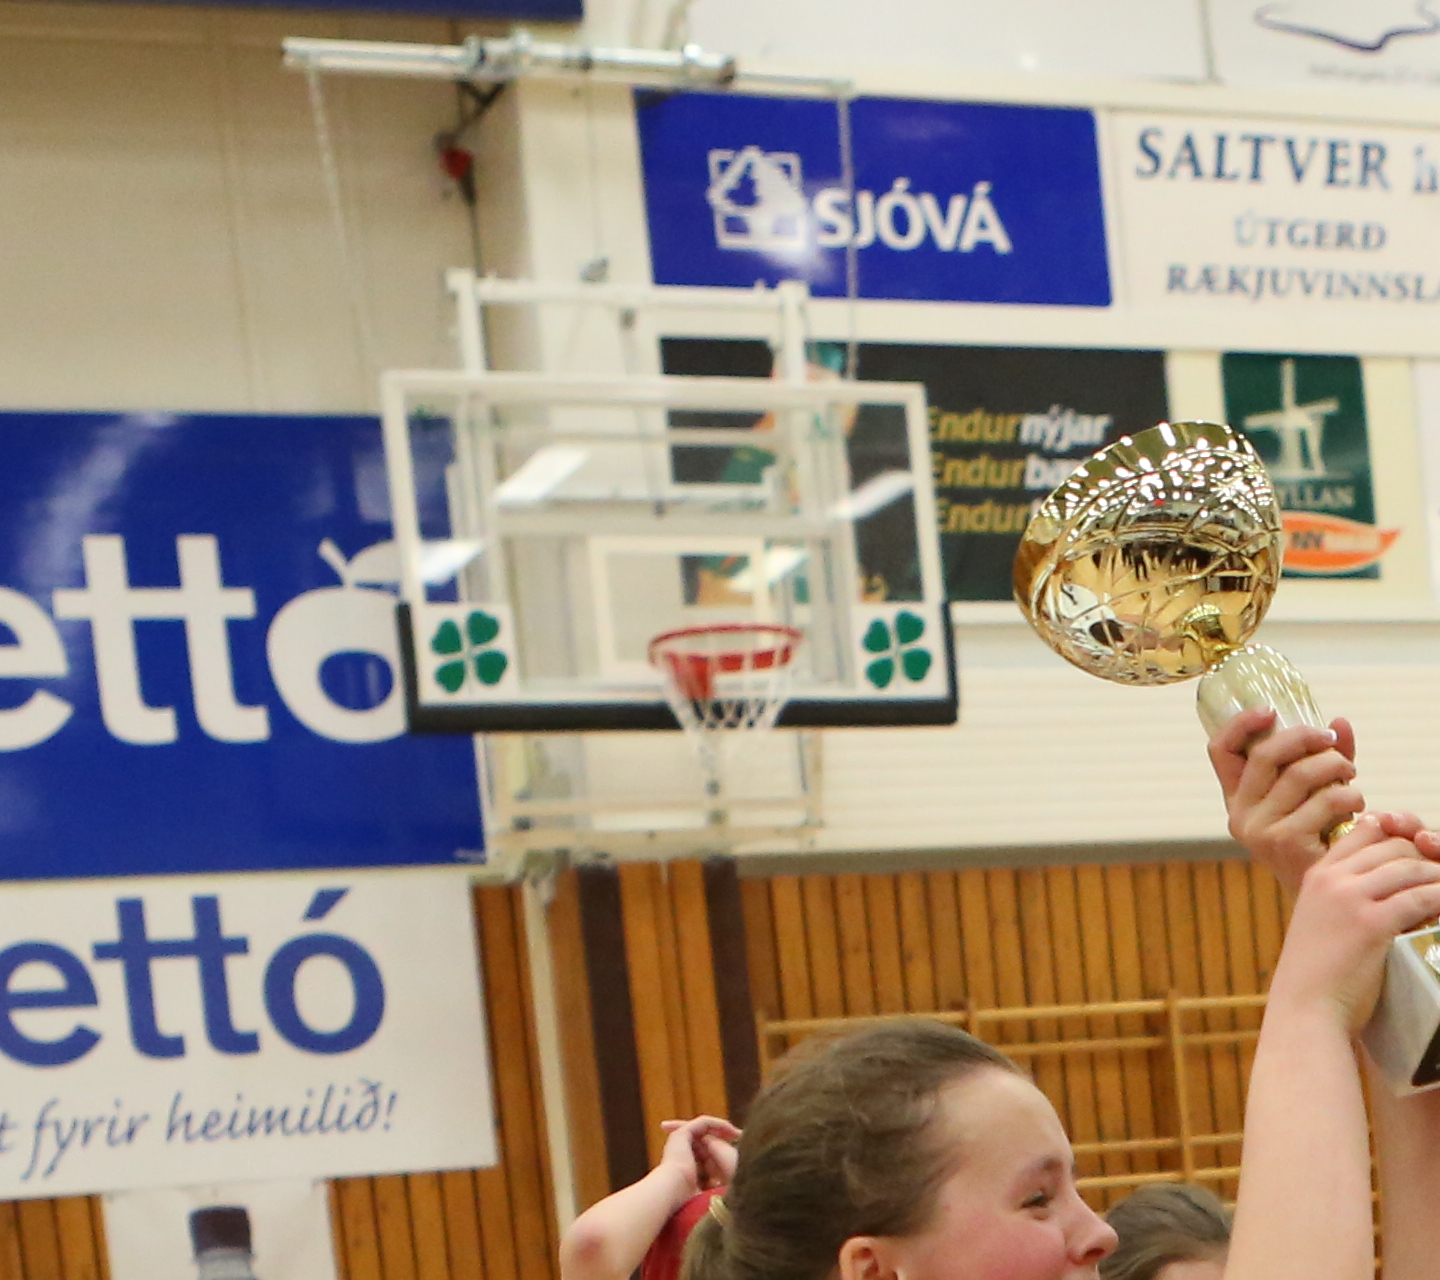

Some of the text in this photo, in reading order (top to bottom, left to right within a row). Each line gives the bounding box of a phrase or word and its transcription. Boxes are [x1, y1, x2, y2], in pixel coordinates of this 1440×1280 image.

[1135, 127, 1391, 192] SALTVER
[811, 177, 1012, 254] SJÓVÁ
[938, 498, 1042, 534] Endur
[18, 1099, 146, 1182] fyrir
[162, 1086, 399, 1147] heimilið!
